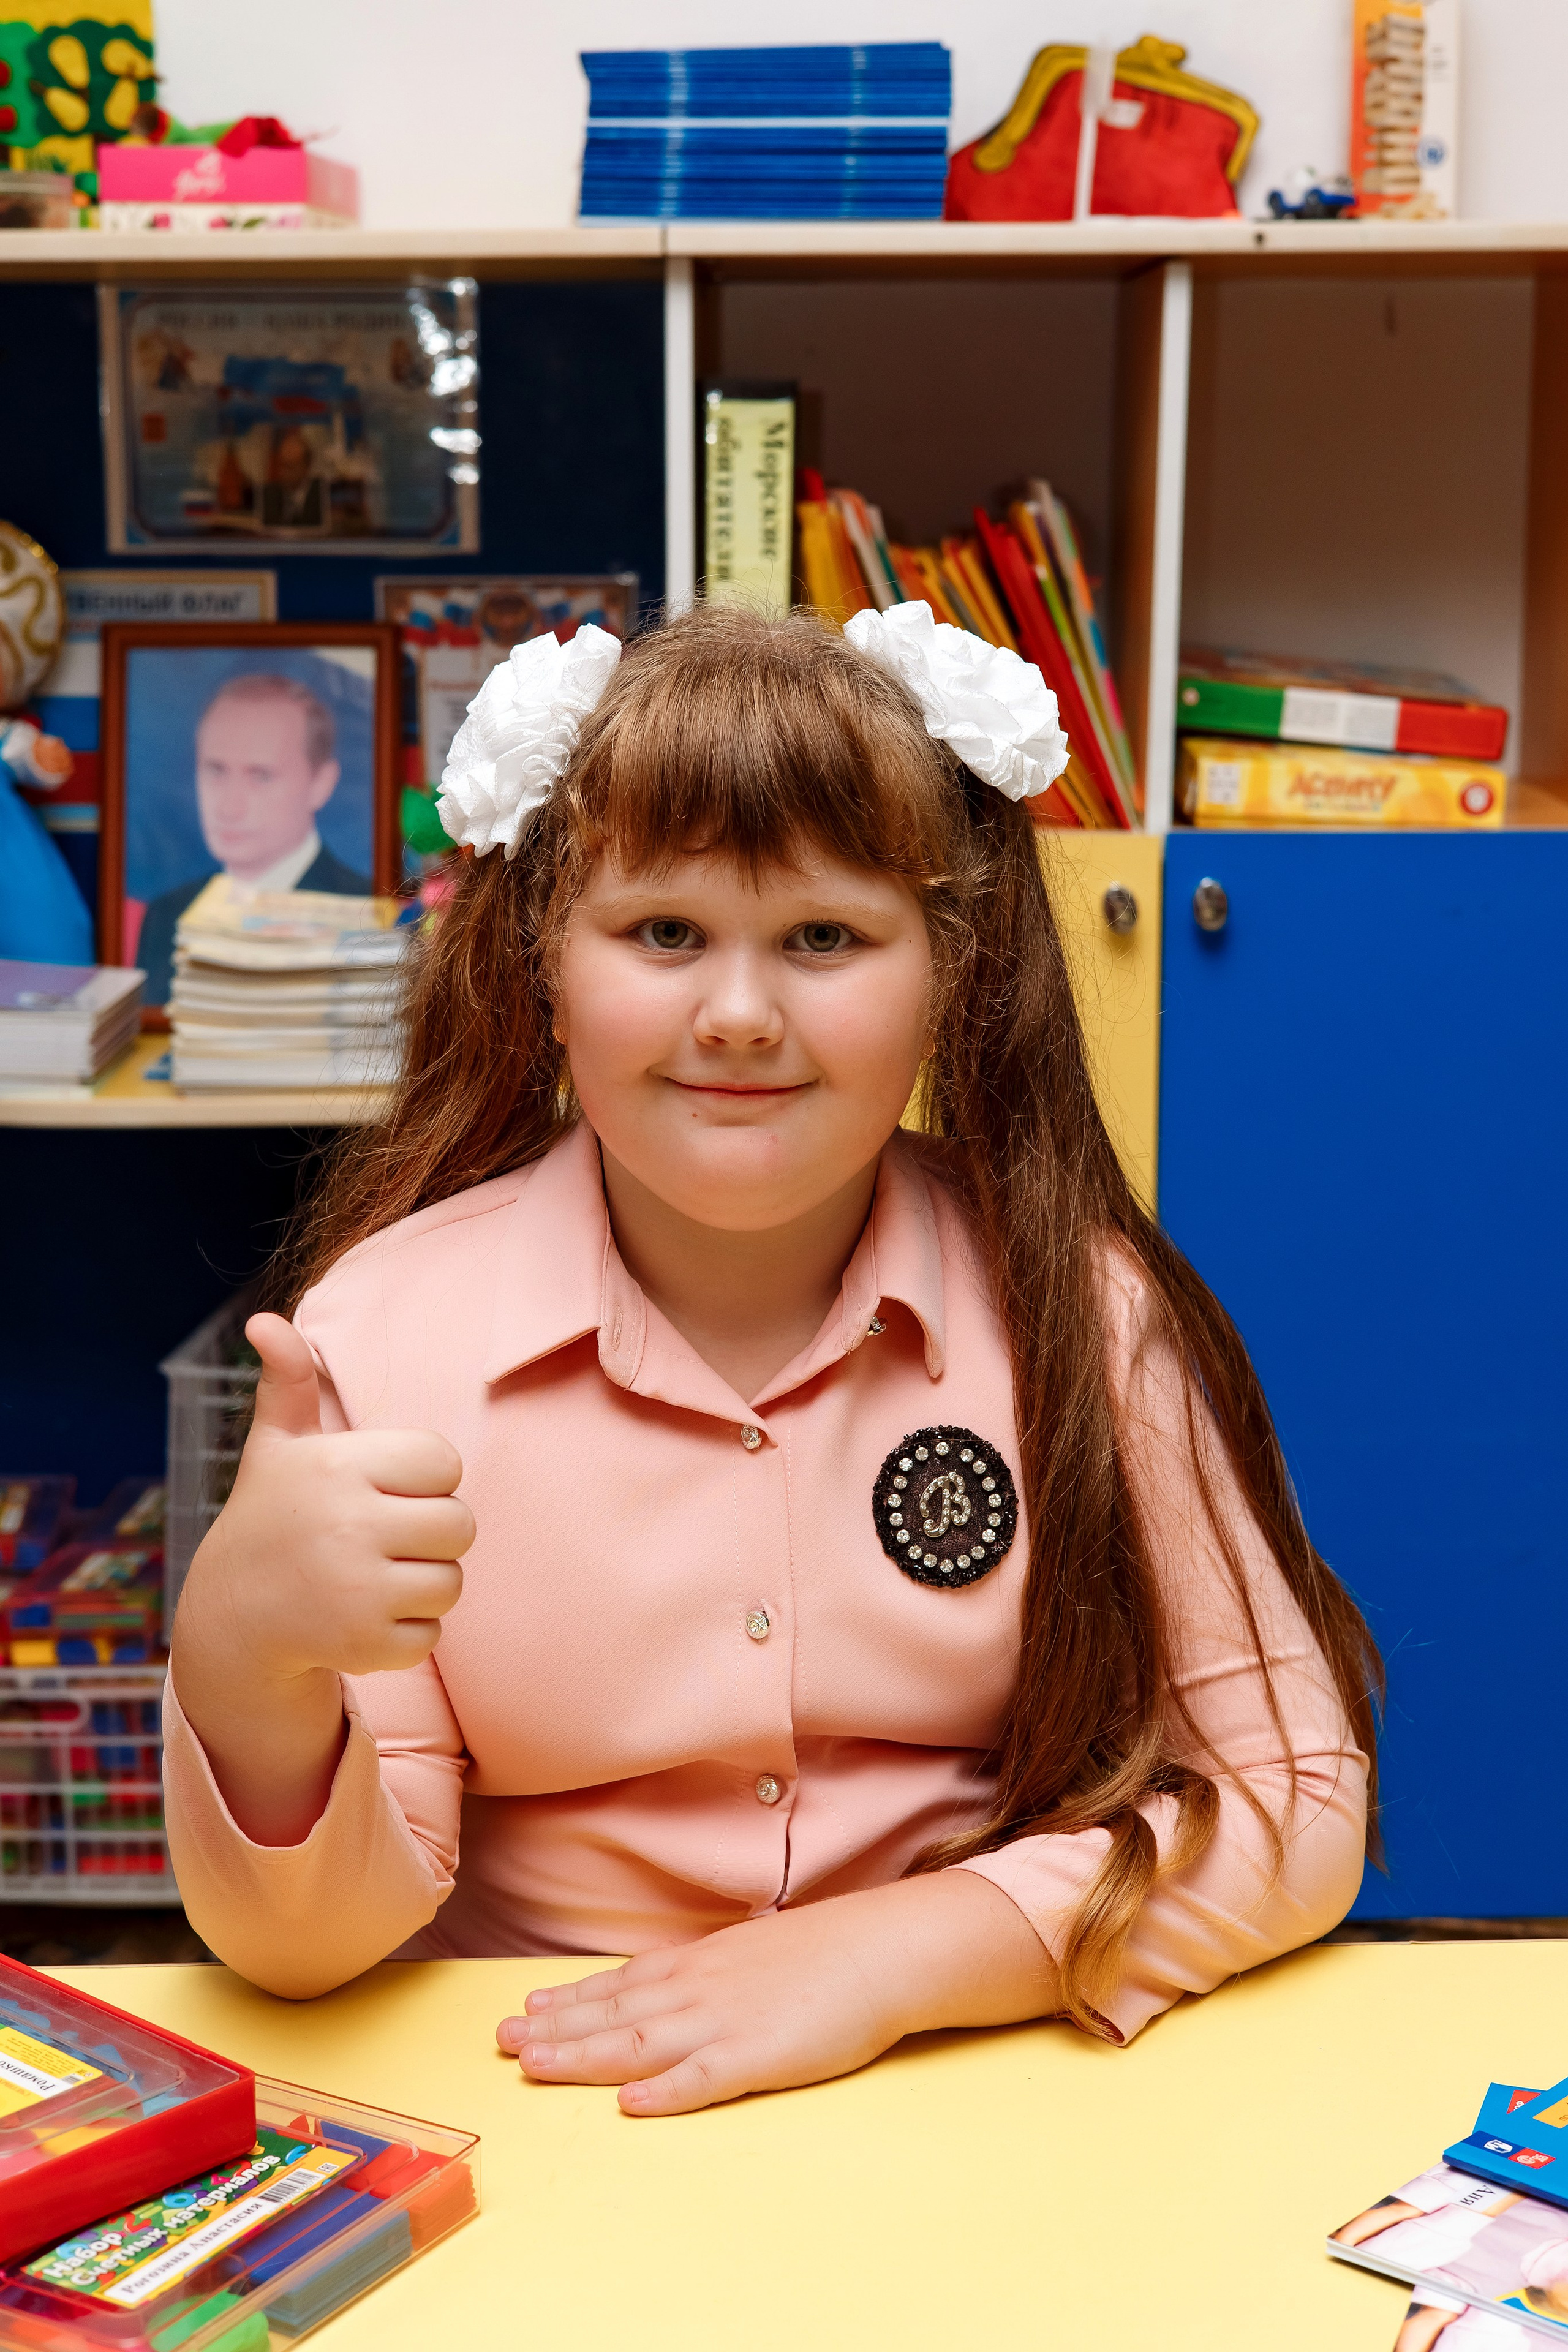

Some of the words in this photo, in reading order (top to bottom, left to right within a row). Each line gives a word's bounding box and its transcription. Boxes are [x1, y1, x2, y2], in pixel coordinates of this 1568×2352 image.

[755, 419, 785, 559] Морские
[1459, 2184, 1496, 2205] Аня
[70, 2228, 168, 2286] Счетных
[163, 2155, 281, 2229] материалов
[189, 2202, 263, 2250] Анастасия
[43, 2231, 123, 2278] Набор
